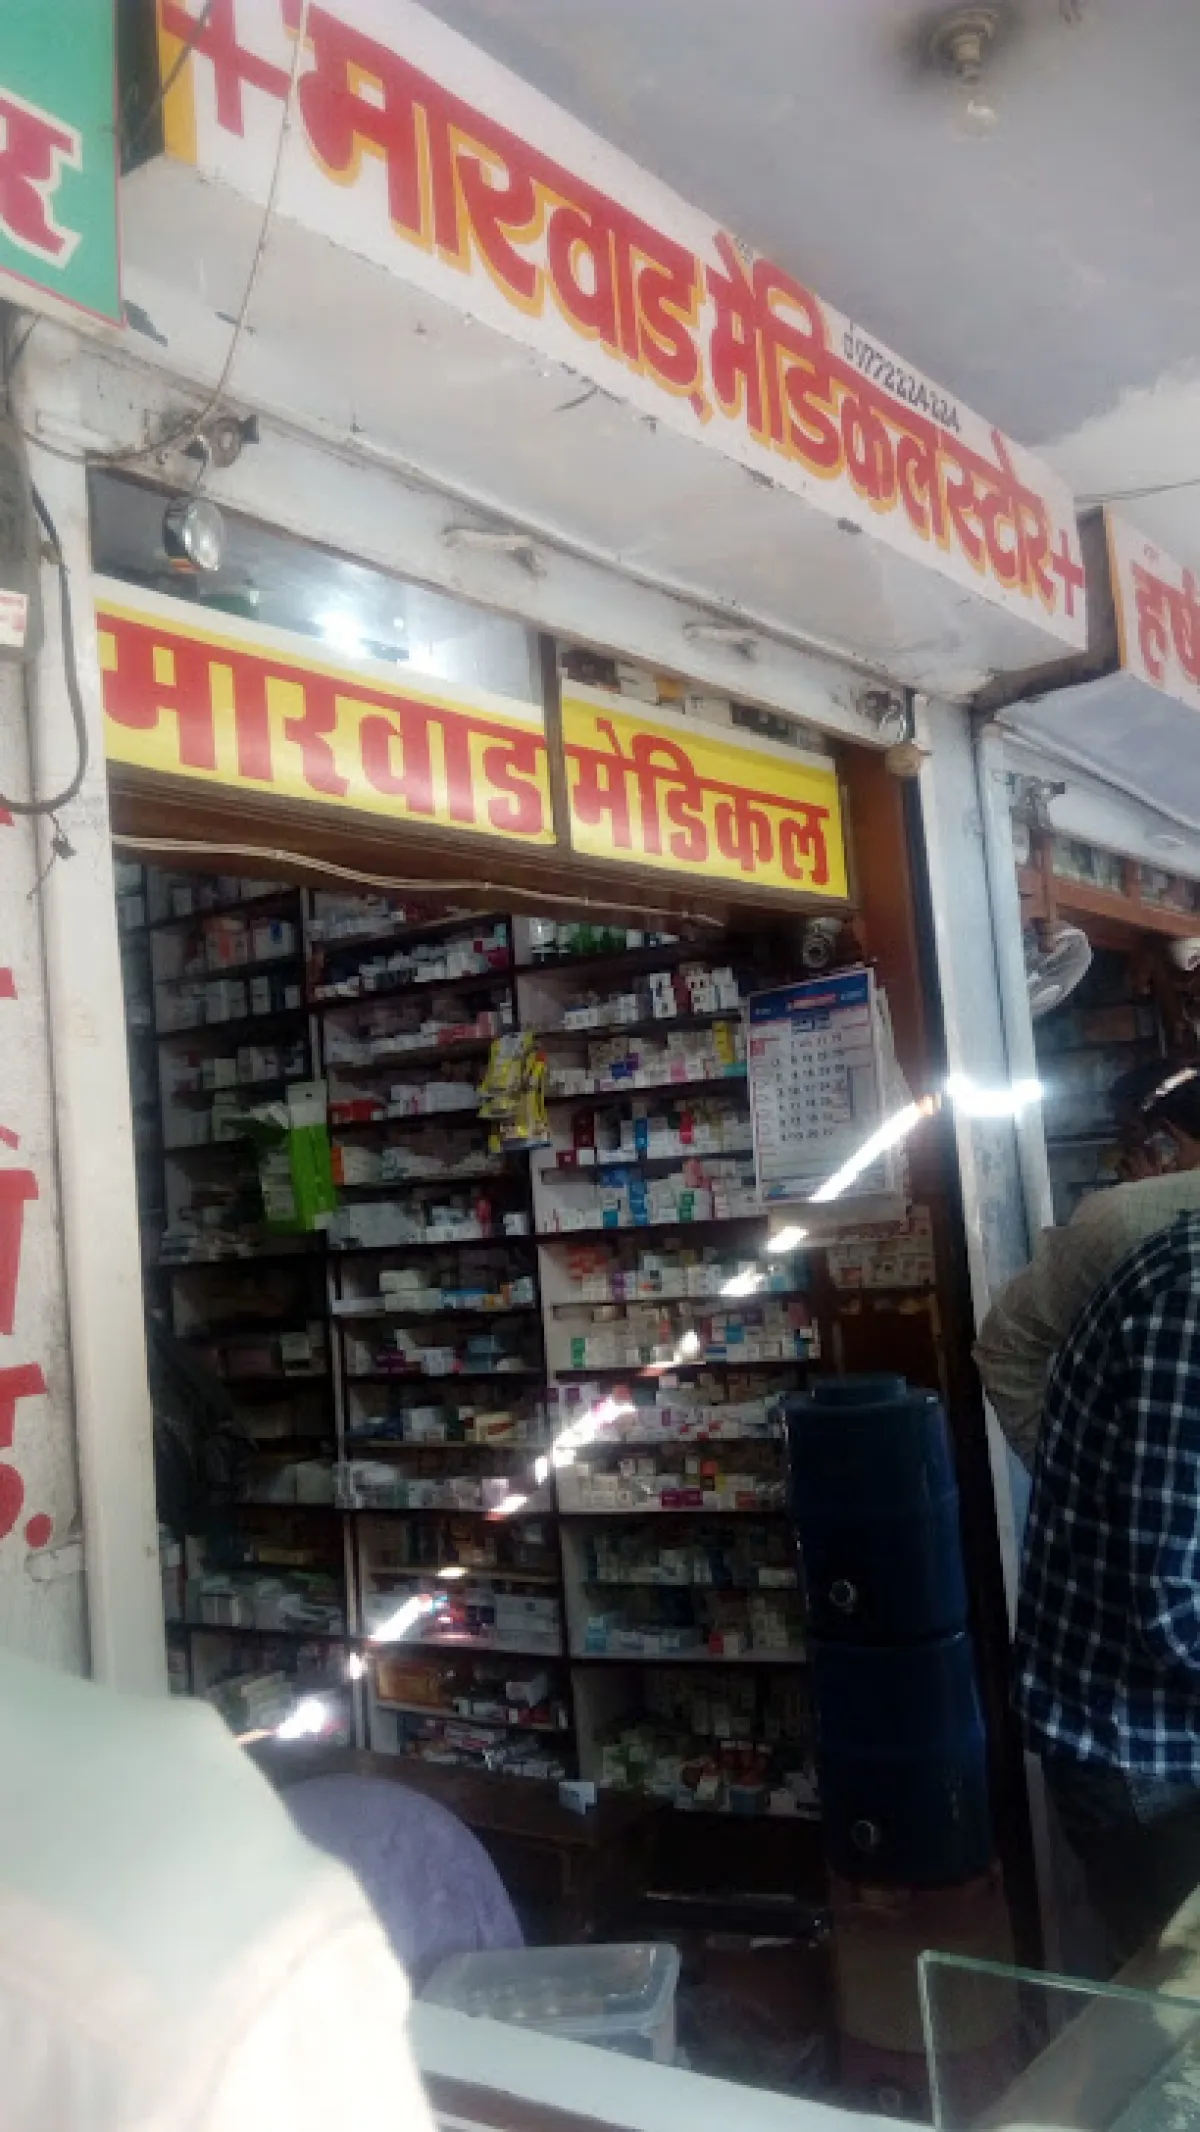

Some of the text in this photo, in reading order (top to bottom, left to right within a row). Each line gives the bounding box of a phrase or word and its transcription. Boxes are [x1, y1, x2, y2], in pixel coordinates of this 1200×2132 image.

[705, 231, 949, 552] मेडिकल
[936, 428, 1056, 614] स्टोर
[564, 717, 829, 885] मेडिकल
